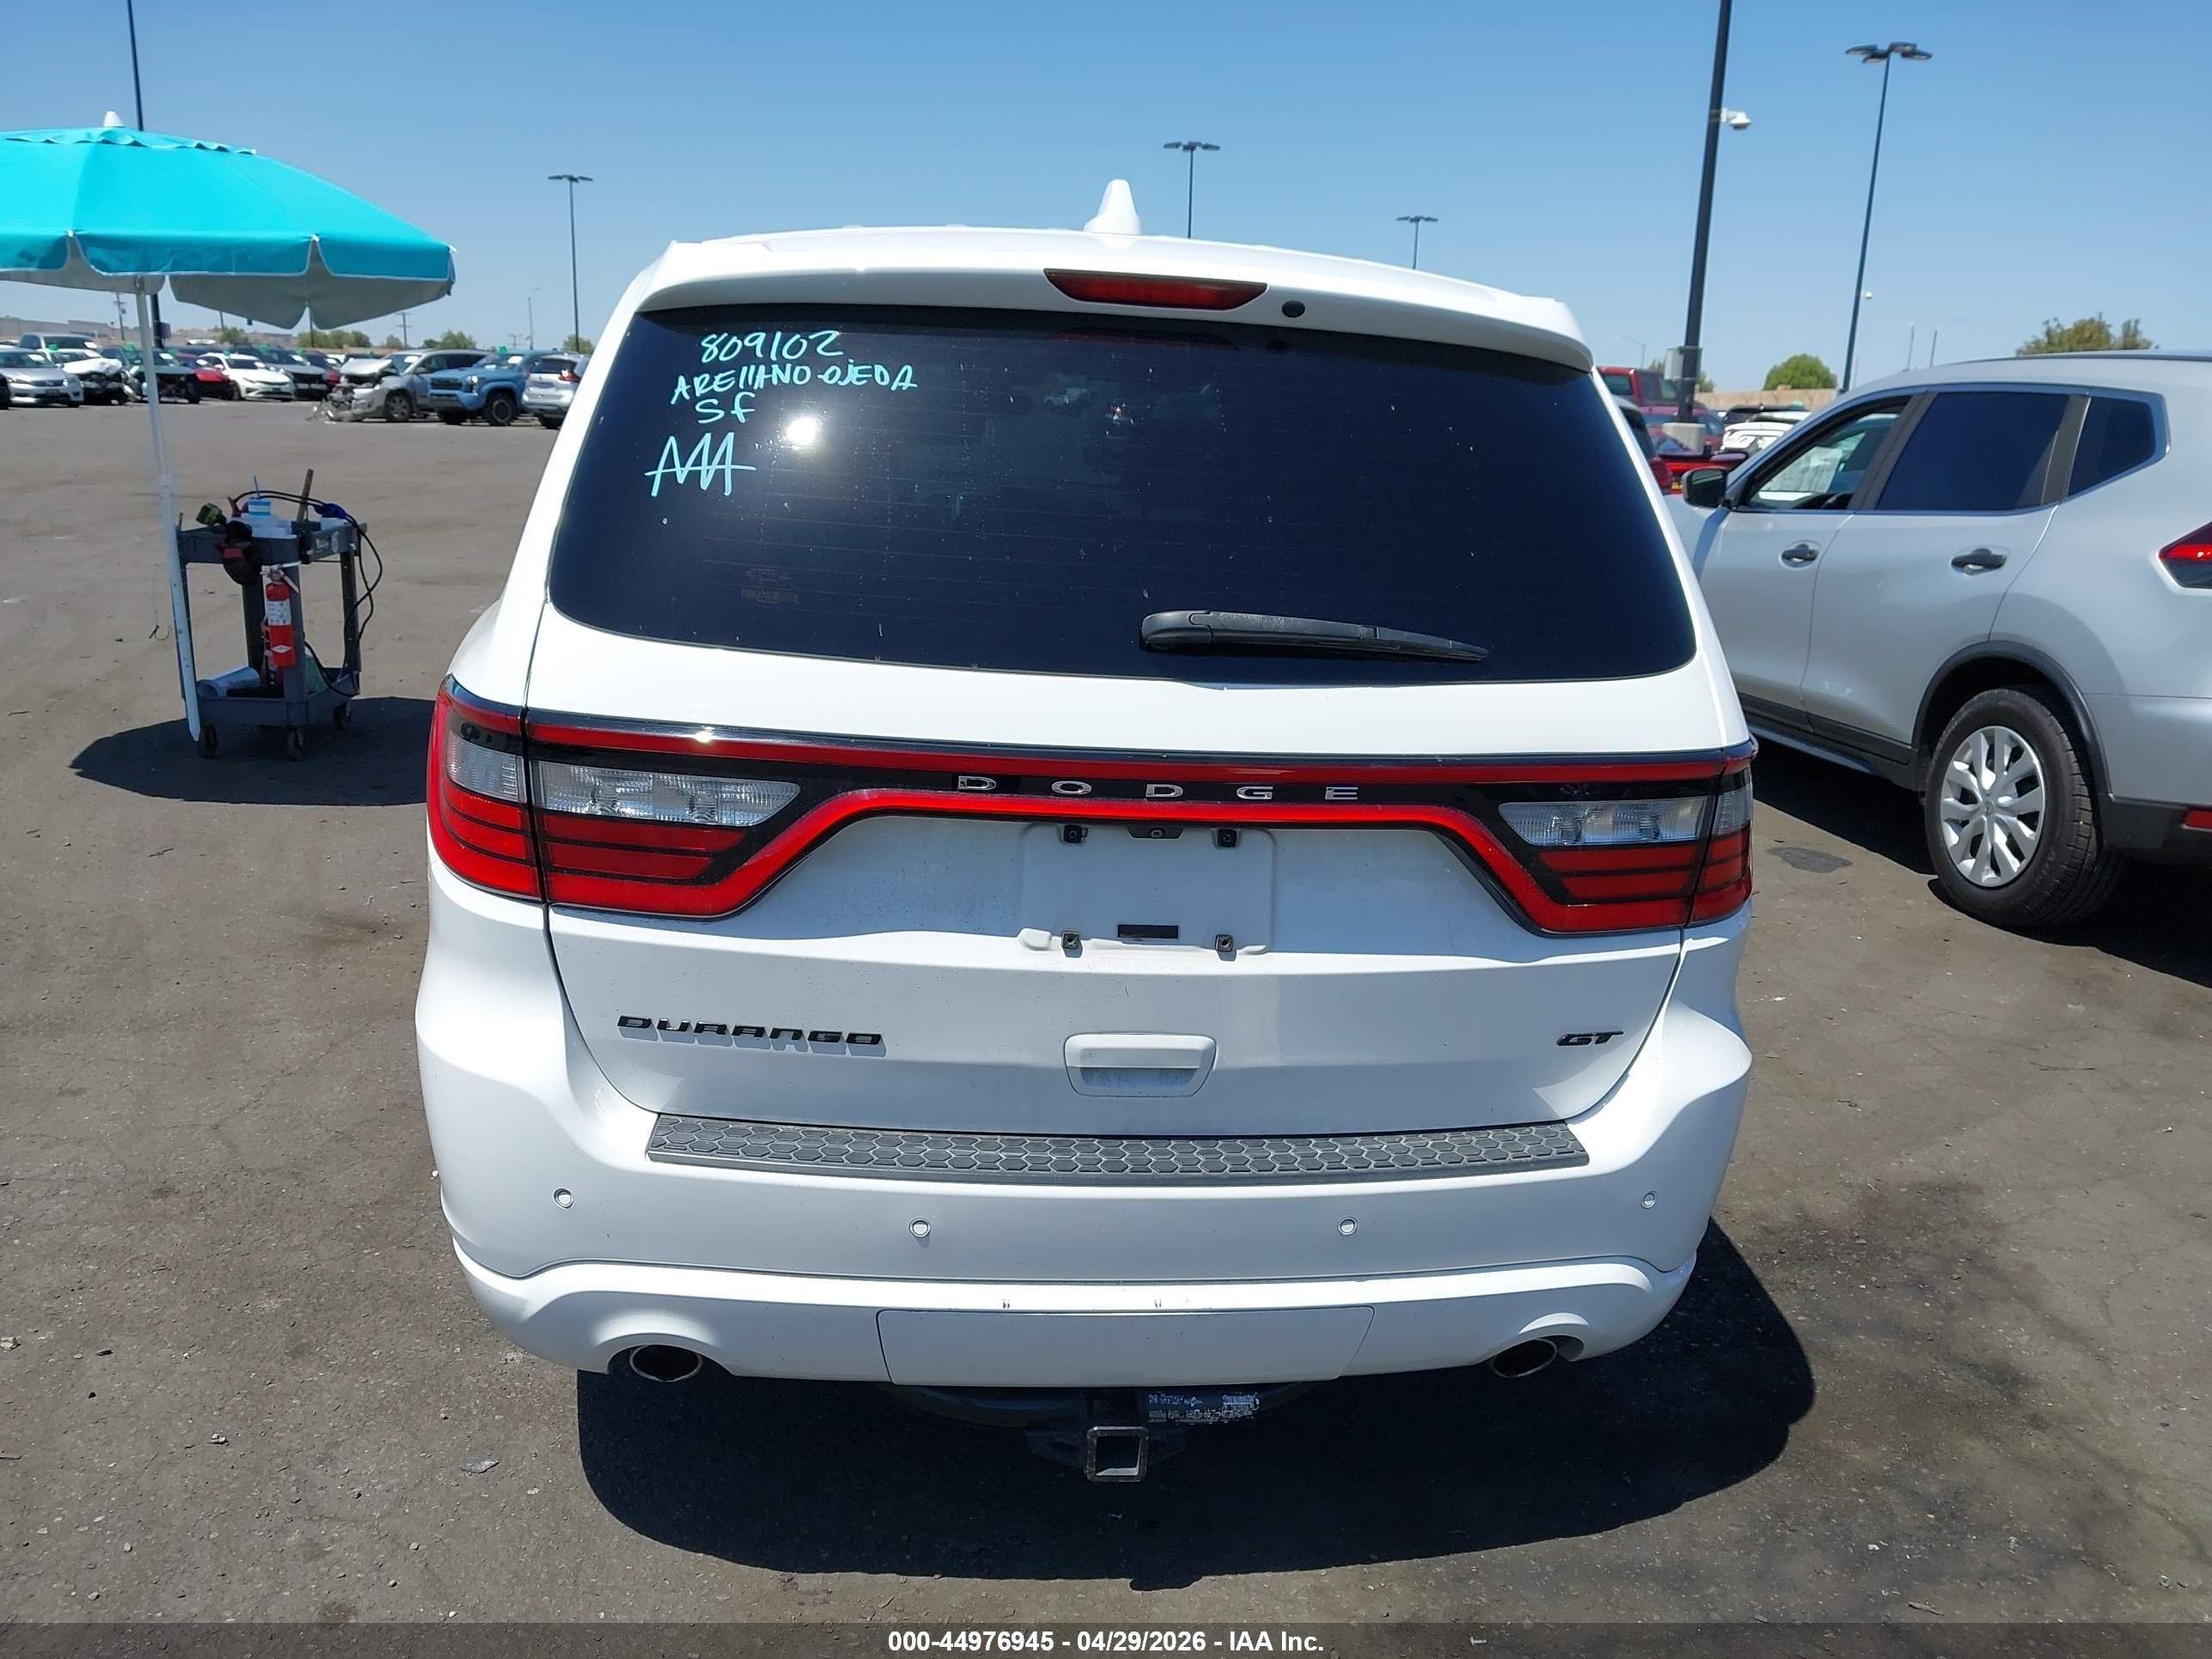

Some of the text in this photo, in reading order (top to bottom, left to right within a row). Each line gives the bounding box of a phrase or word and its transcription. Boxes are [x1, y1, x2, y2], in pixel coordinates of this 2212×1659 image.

[701, 330, 844, 363] 809102
[957, 775, 1358, 799] DODGE
[617, 1015, 883, 1045] DURANGO
[1556, 1030, 1624, 1046] GT
